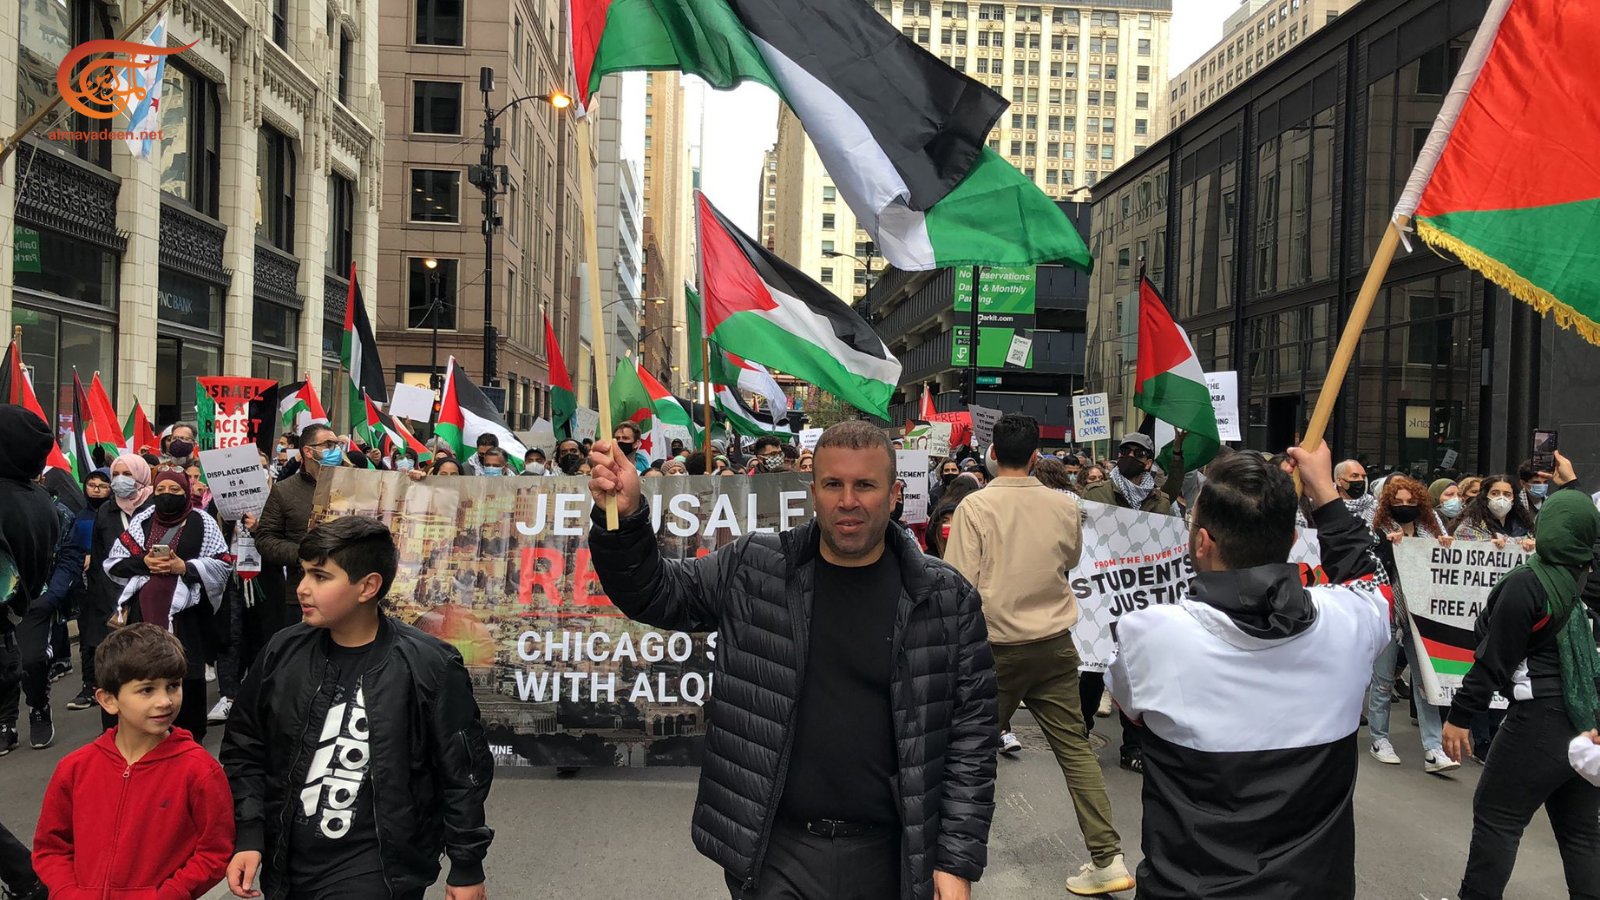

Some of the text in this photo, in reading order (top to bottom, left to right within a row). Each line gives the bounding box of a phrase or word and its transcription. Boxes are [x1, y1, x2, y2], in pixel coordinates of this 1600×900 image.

[959, 270, 1032, 281] No eservations.
[982, 284, 989, 292] &
[991, 284, 1026, 295] Monthly
[958, 294, 993, 305] Paring.
[206, 385, 263, 400] ISRAEL
[1079, 396, 1102, 406] END
[213, 402, 245, 415] IS A
[1079, 407, 1104, 418] ISRAELI
[205, 419, 262, 433] RACIST
[1079, 426, 1107, 437] CRIMES
[207, 464, 260, 479] DISPLACEMENT
[221, 486, 262, 499] WAR CRIME
[1094, 559, 1117, 569] FROM
[1120, 555, 1140, 564] THE
[1144, 550, 1172, 562] RIVER
[1174, 546, 1182, 555] TO
[1431, 548, 1463, 564] END
[1466, 549, 1512, 568] ISRAELI
[1071, 554, 1194, 599] STUDENTS
[1430, 568, 1459, 585] THE
[1430, 599, 1465, 617] FREE
[516, 631, 693, 662] CHICAGO
[515, 671, 615, 703] WITH
